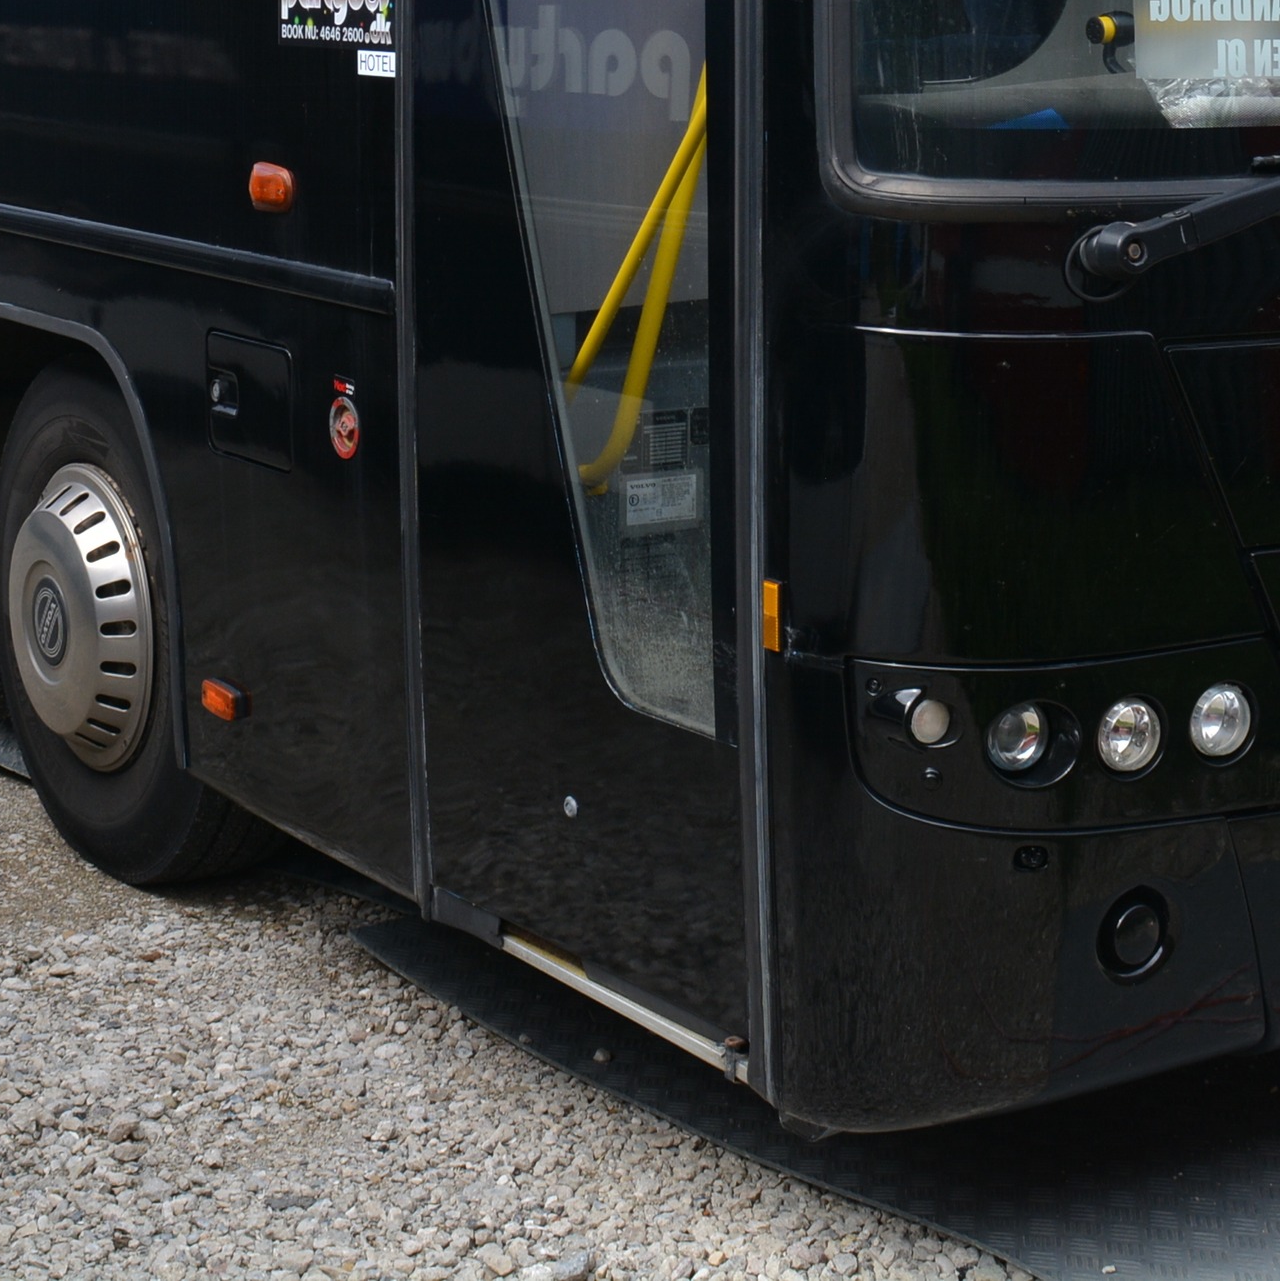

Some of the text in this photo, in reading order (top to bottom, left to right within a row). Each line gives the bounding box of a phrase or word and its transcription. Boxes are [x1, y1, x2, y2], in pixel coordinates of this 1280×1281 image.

[281, 23, 364, 43] BOOK NU: 4646 2600
[359, 53, 395, 73] HOTEL
[630, 482, 656, 490] VOLVO
[40, 602, 57, 644] VOLVO
